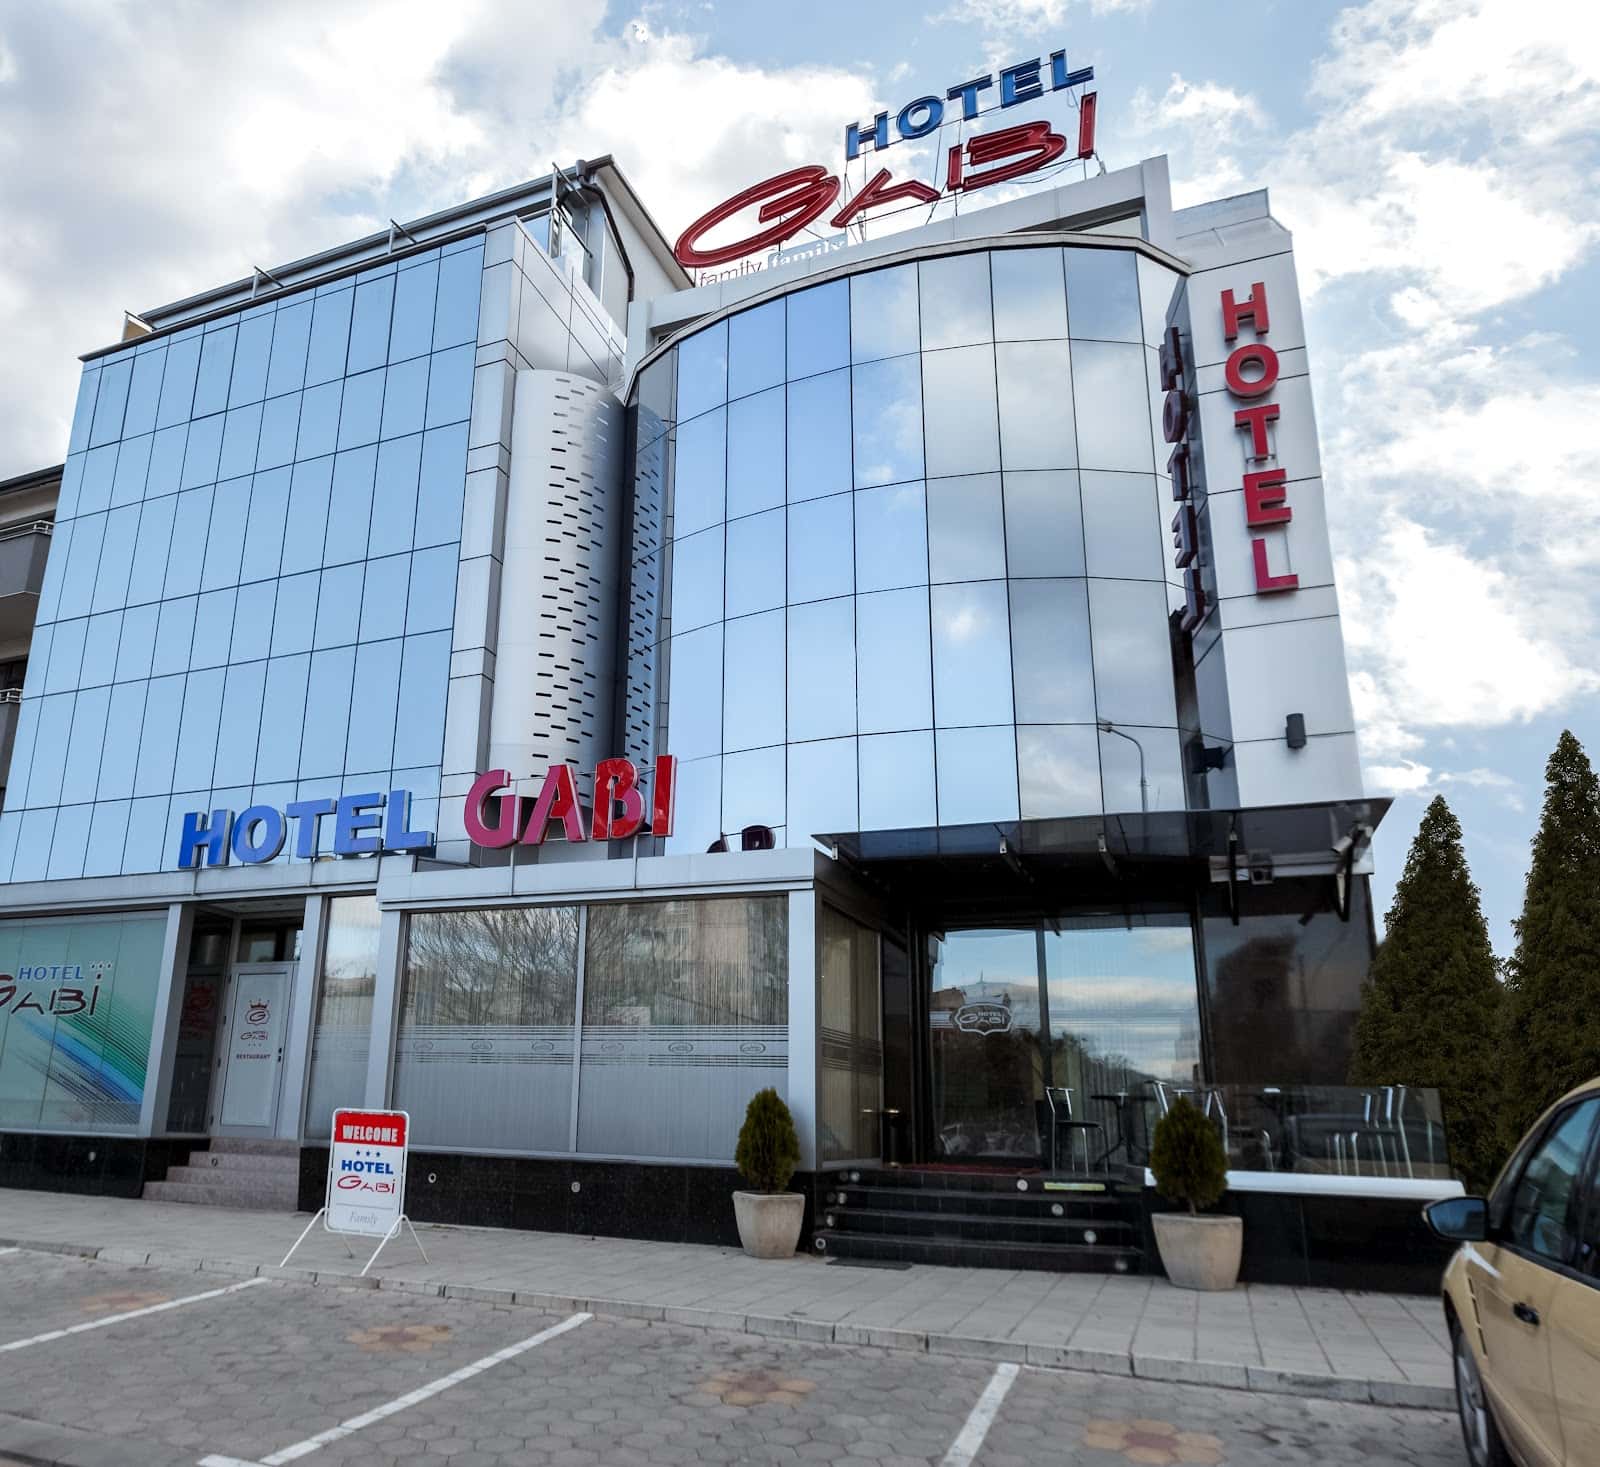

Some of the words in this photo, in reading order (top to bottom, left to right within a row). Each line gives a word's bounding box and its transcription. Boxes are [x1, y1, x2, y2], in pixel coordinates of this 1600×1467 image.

[845, 48, 1094, 161] HOTEL
[1220, 281, 1299, 595] HOTEL
[178, 789, 434, 869] HOTEL
[463, 755, 678, 849] GABI
[19, 966, 84, 980] HOTEL
[342, 1124, 399, 1143] WELCOME
[341, 1160, 394, 1175] HOTEL
